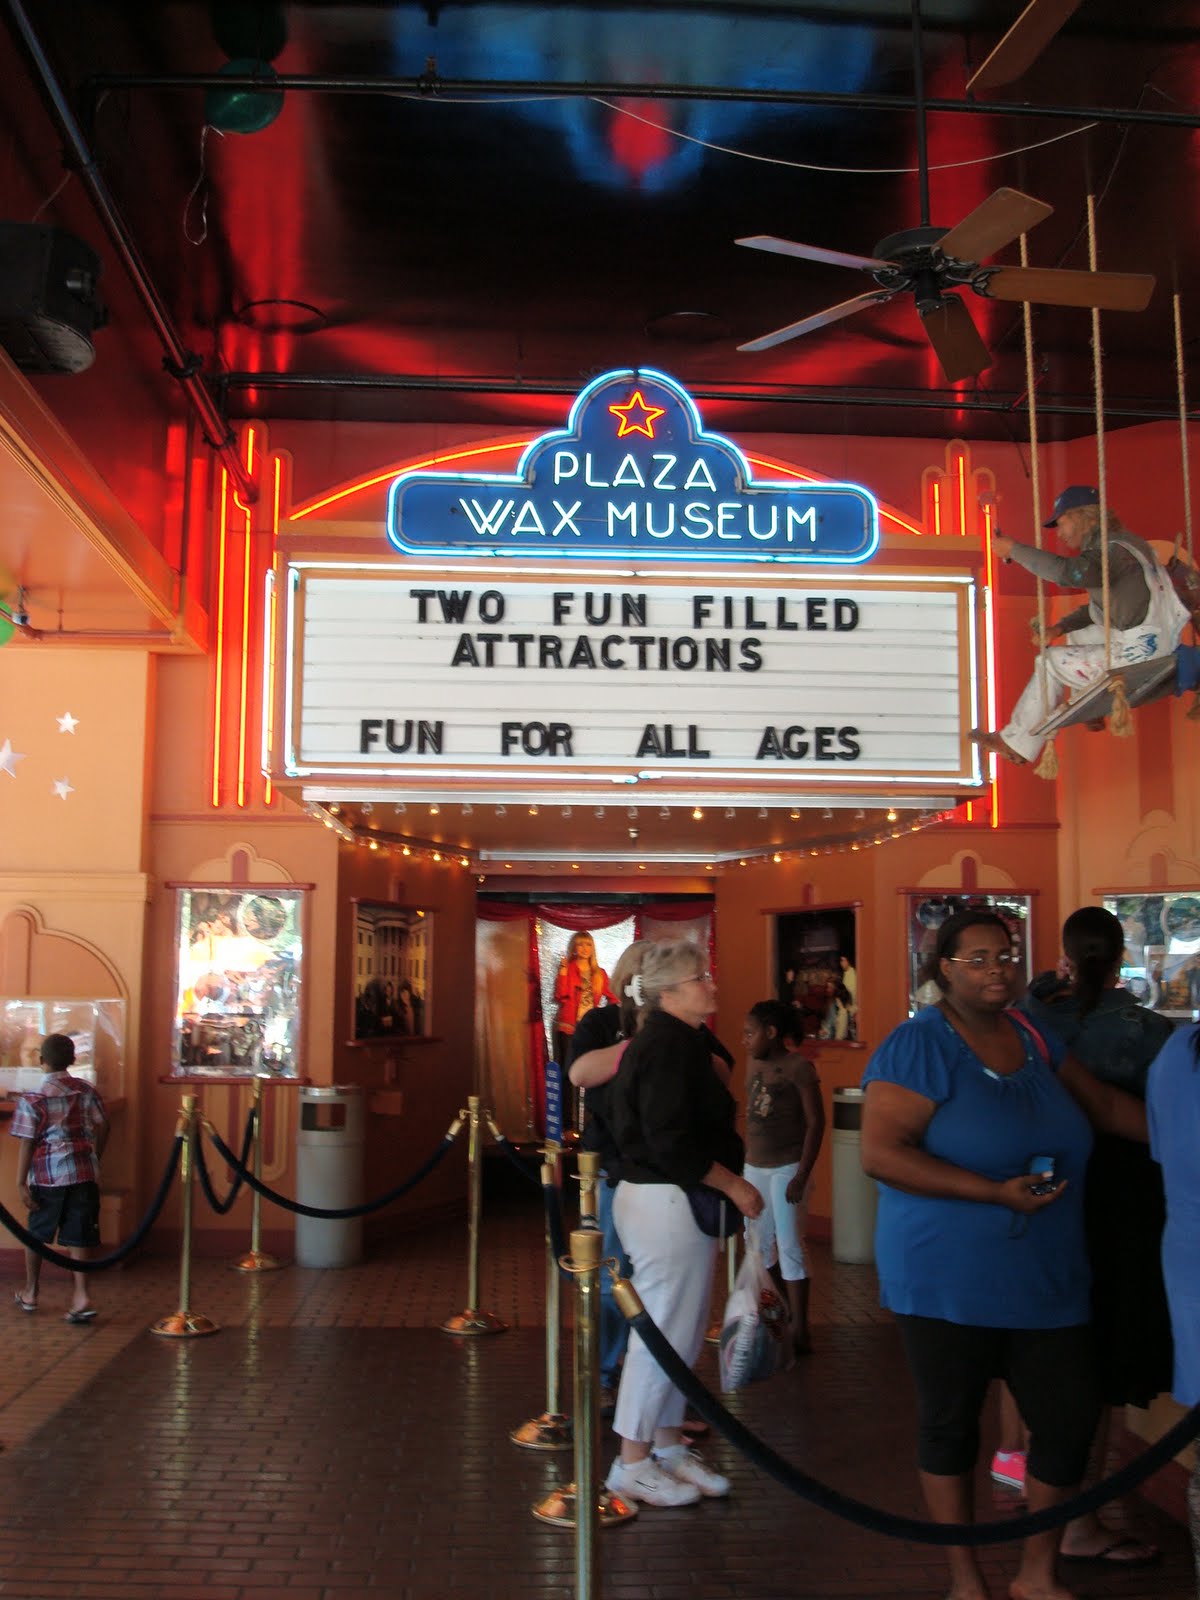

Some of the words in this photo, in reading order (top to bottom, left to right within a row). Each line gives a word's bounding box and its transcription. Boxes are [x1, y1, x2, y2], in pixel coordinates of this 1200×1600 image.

[552, 451, 718, 494] PLAZA
[459, 497, 582, 538] WAX
[606, 500, 818, 542] MUSEUM
[410, 589, 506, 625] TWO
[552, 592, 648, 627] FUN
[693, 596, 860, 632] FILLED
[451, 634, 764, 672] ATTRACTIONS
[360, 718, 444, 755] FUN
[501, 721, 573, 757] FOR
[636, 723, 710, 759] ALL
[755, 725, 861, 761] AGES
